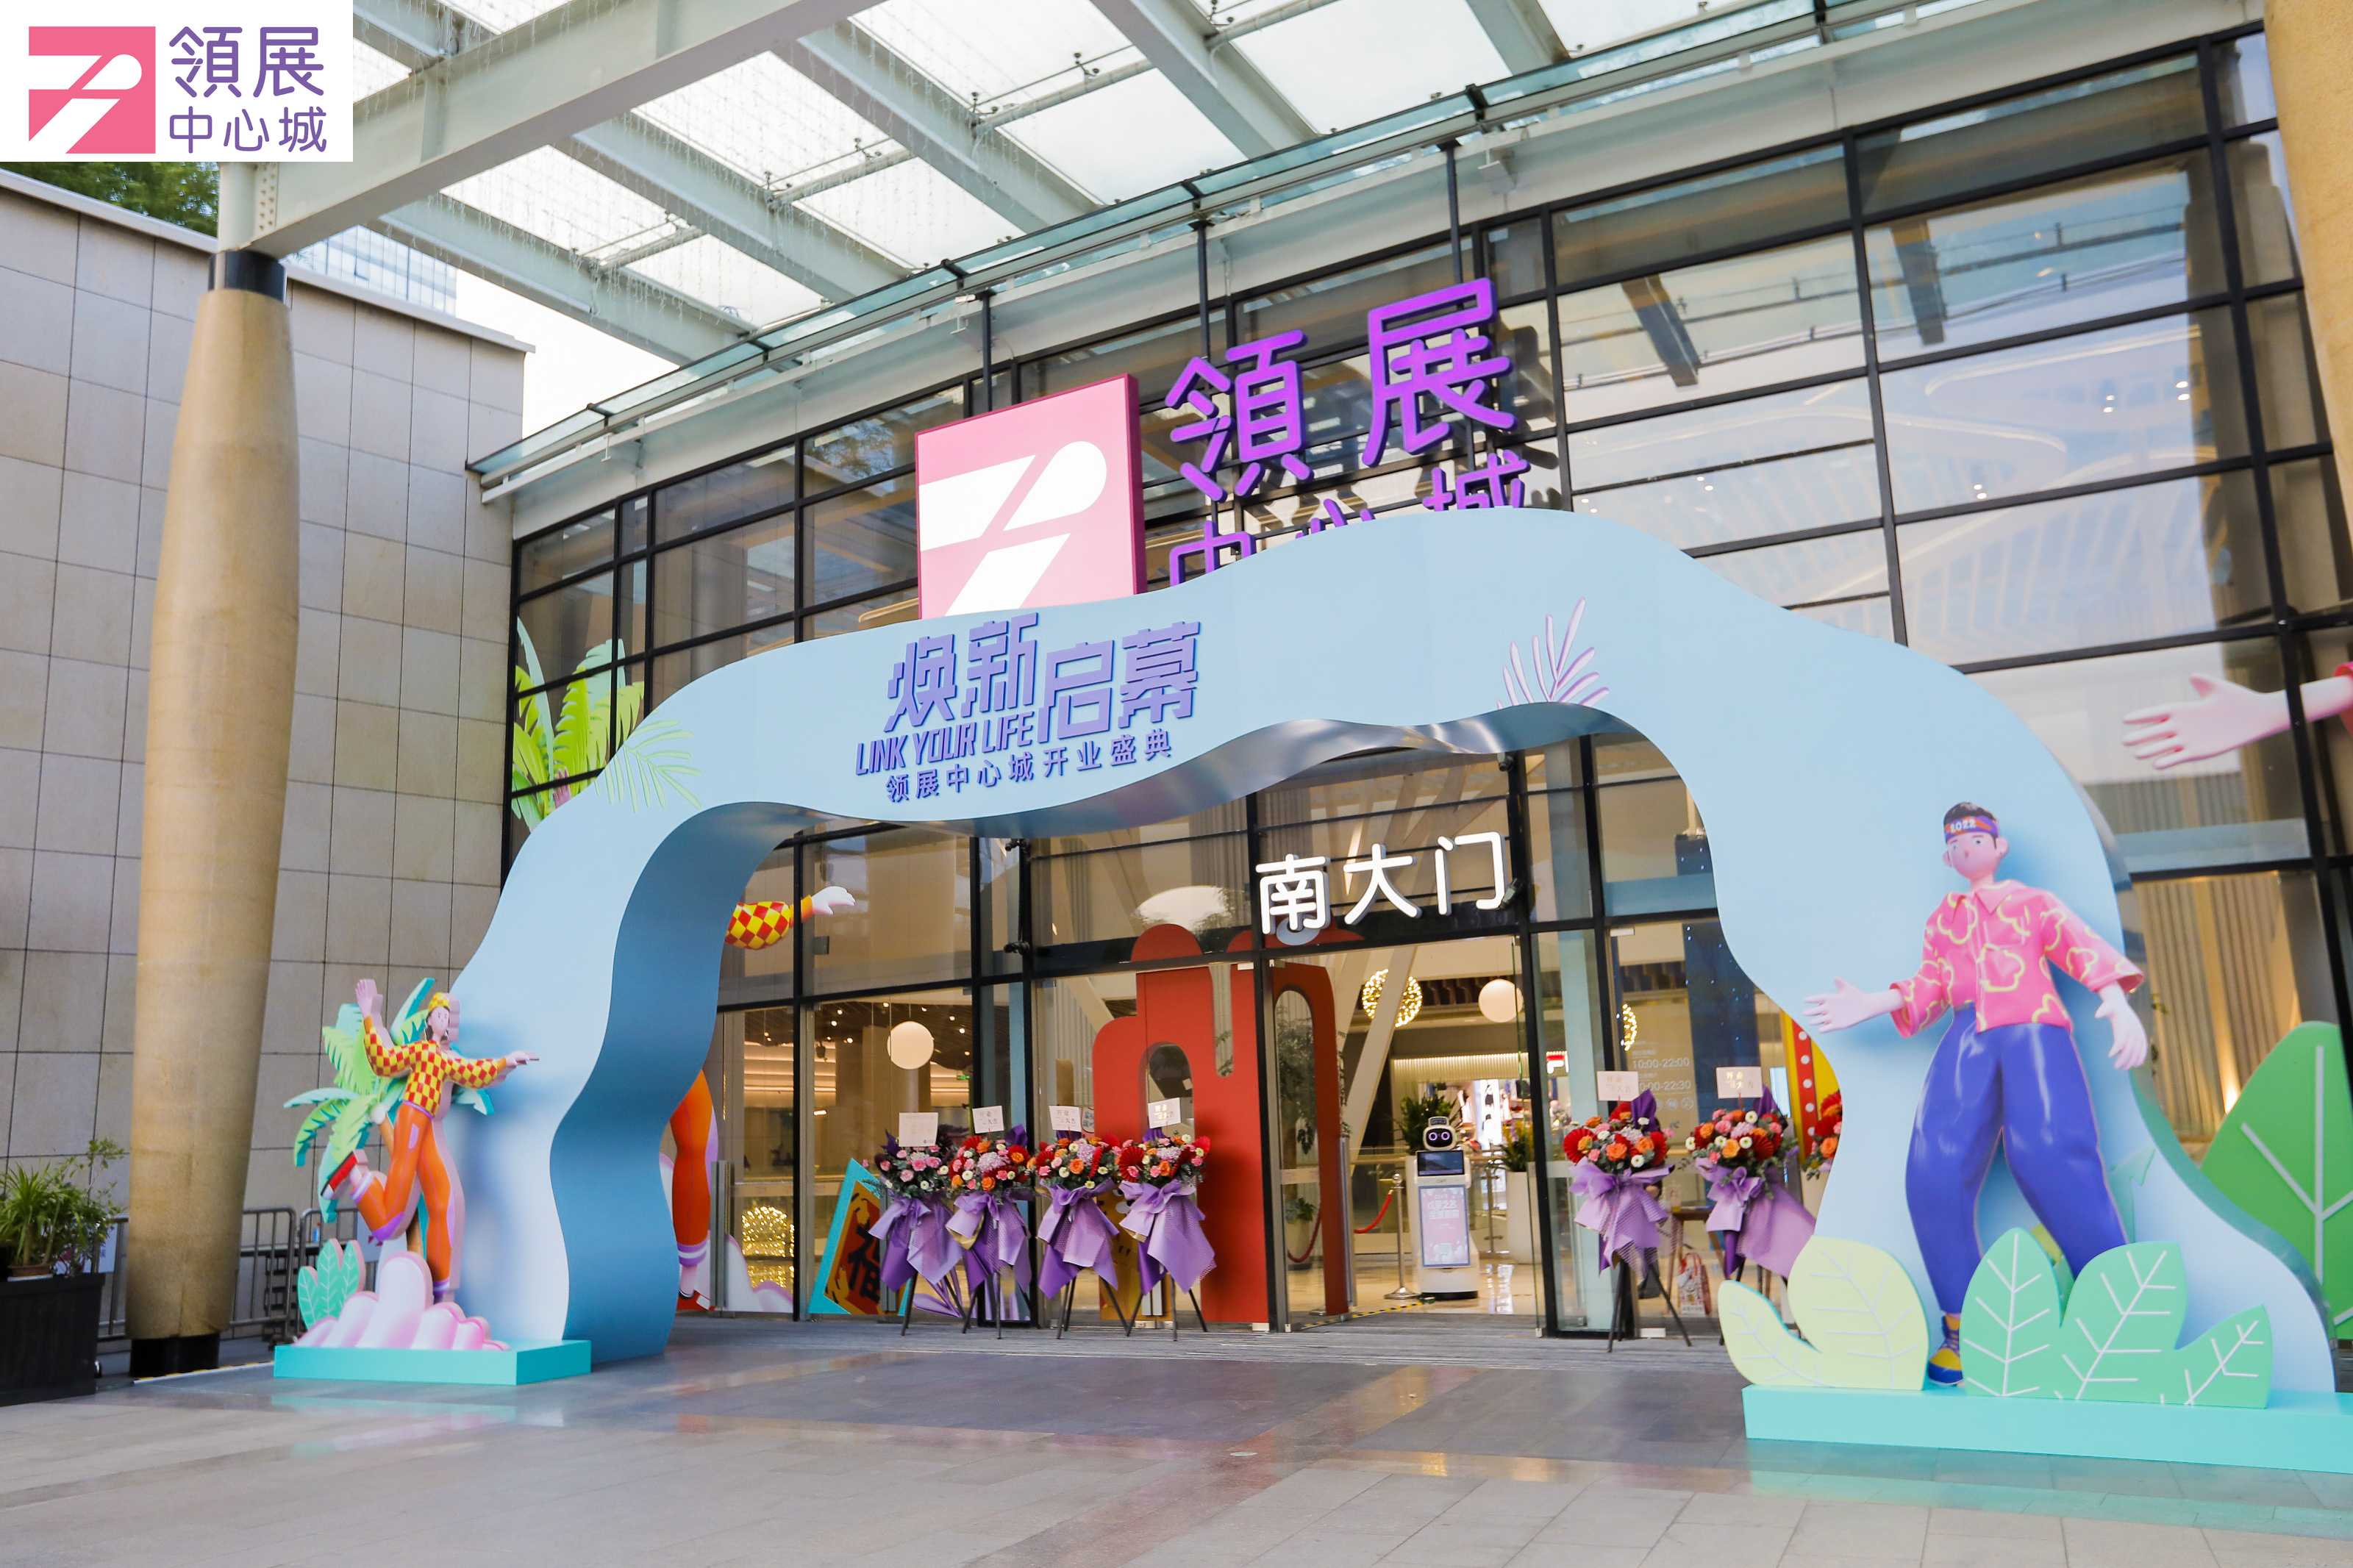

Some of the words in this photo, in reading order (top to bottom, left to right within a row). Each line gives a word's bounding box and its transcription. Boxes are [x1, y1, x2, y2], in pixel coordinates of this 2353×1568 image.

[1165, 277, 1521, 503] 領展
[883, 612, 1202, 745] 焕新启幕
[855, 735, 907, 776] LINK
[914, 722, 978, 765] YOUR
[982, 711, 1036, 754] LIFE
[885, 727, 1172, 803] 领展中心城开业盛典
[1950, 818, 1977, 834] 2022
[1255, 831, 1507, 935] 南大门
[1632, 1056, 1690, 1070] 10:00-22:00
[1639, 1079, 1692, 1092] 0:00-22:30
